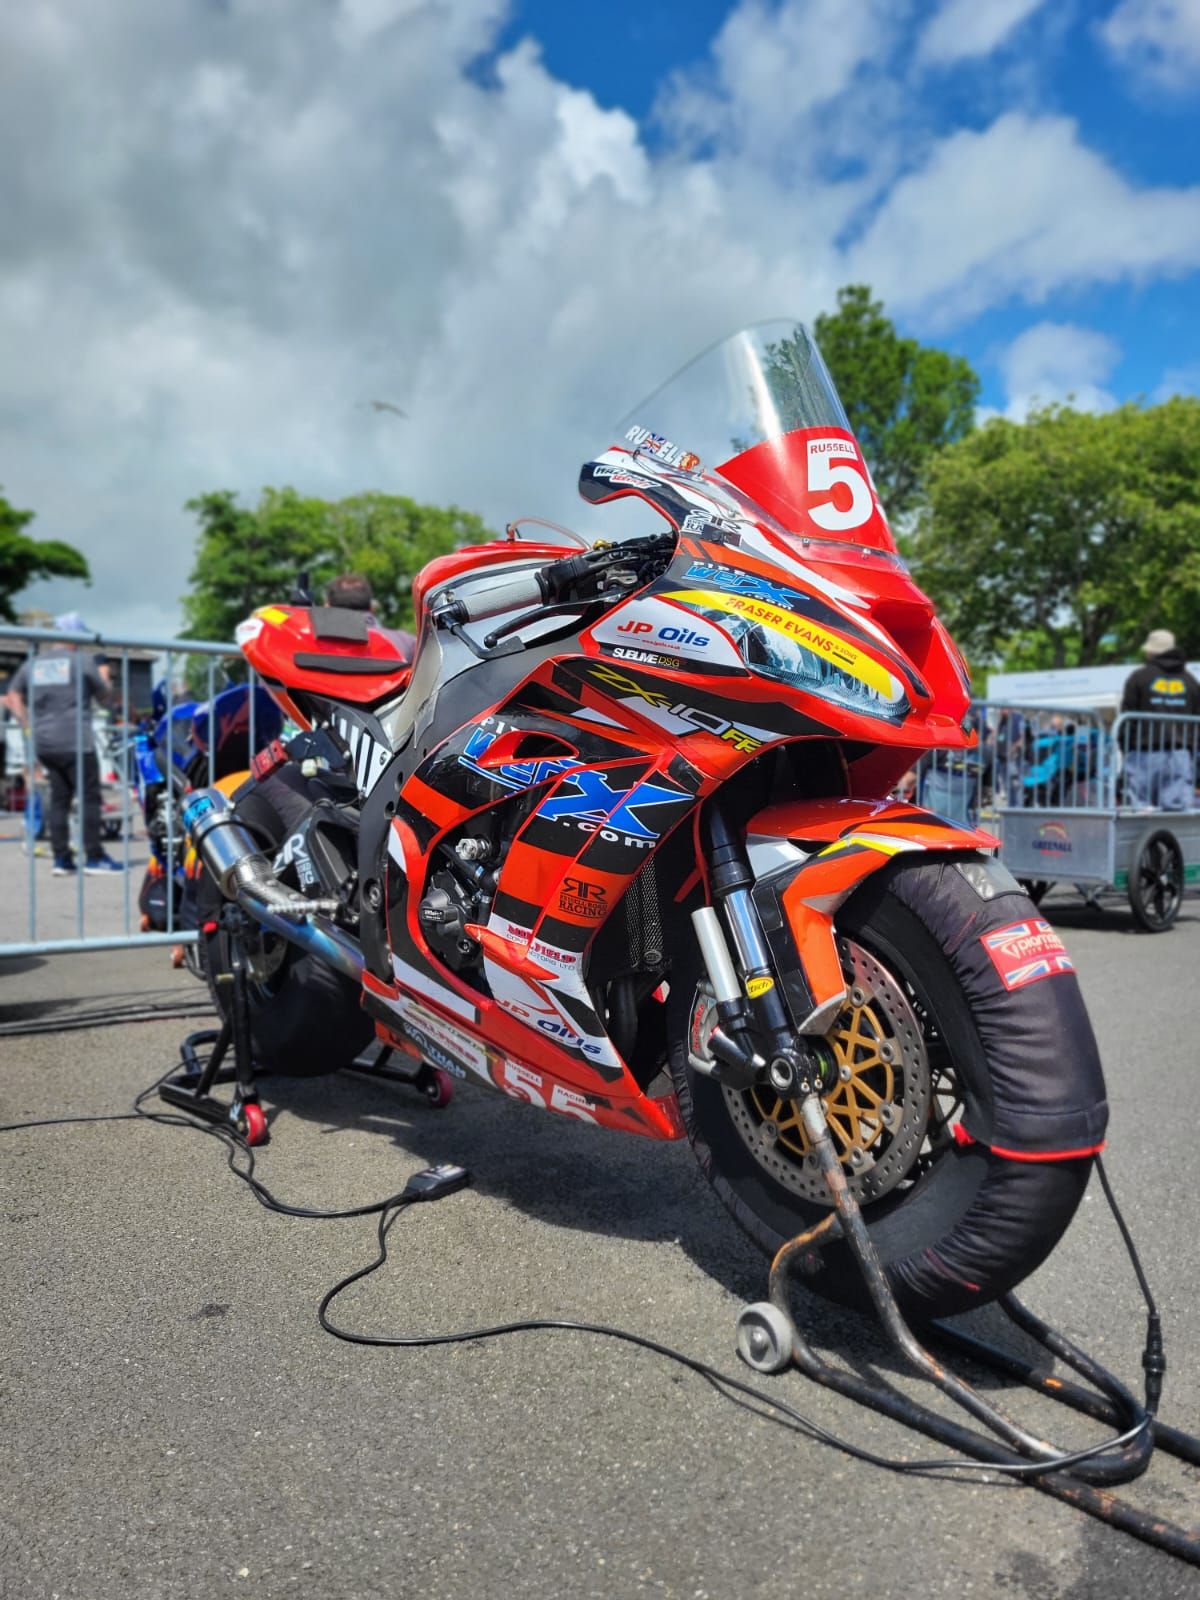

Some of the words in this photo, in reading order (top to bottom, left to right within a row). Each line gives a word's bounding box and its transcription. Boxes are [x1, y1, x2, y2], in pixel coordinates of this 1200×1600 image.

[807, 438, 874, 531] 5
[617, 620, 654, 634] JP
[658, 627, 711, 647] Oils
[725, 596, 784, 625] FRASER
[783, 620, 834, 652] EVANS
[559, 899, 608, 918] RACING
